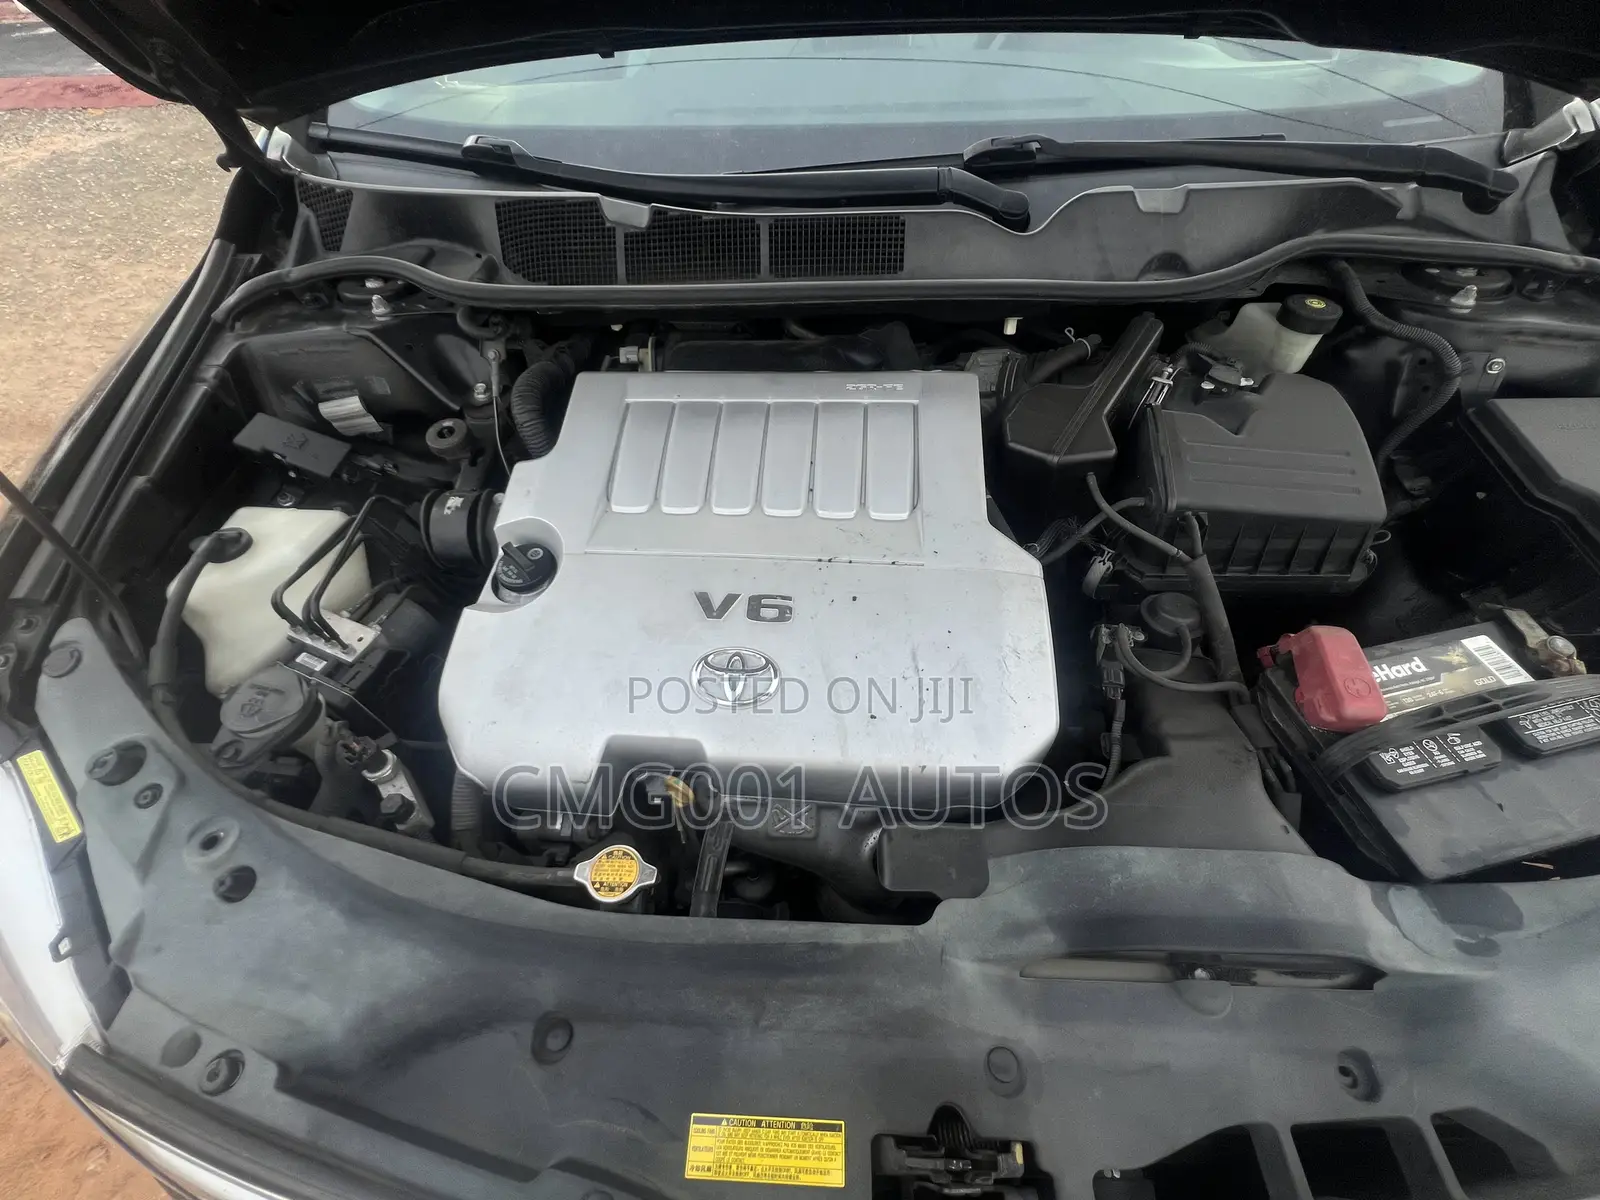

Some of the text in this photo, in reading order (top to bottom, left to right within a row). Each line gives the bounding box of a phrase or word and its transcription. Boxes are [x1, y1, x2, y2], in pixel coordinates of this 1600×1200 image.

[693, 591, 793, 623] V6
[1372, 656, 1429, 683] eHard
[1473, 676, 1497, 686] GOLD
[728, 1118, 756, 1128] CAUTION
[761, 1120, 796, 1130] ATTENTION
